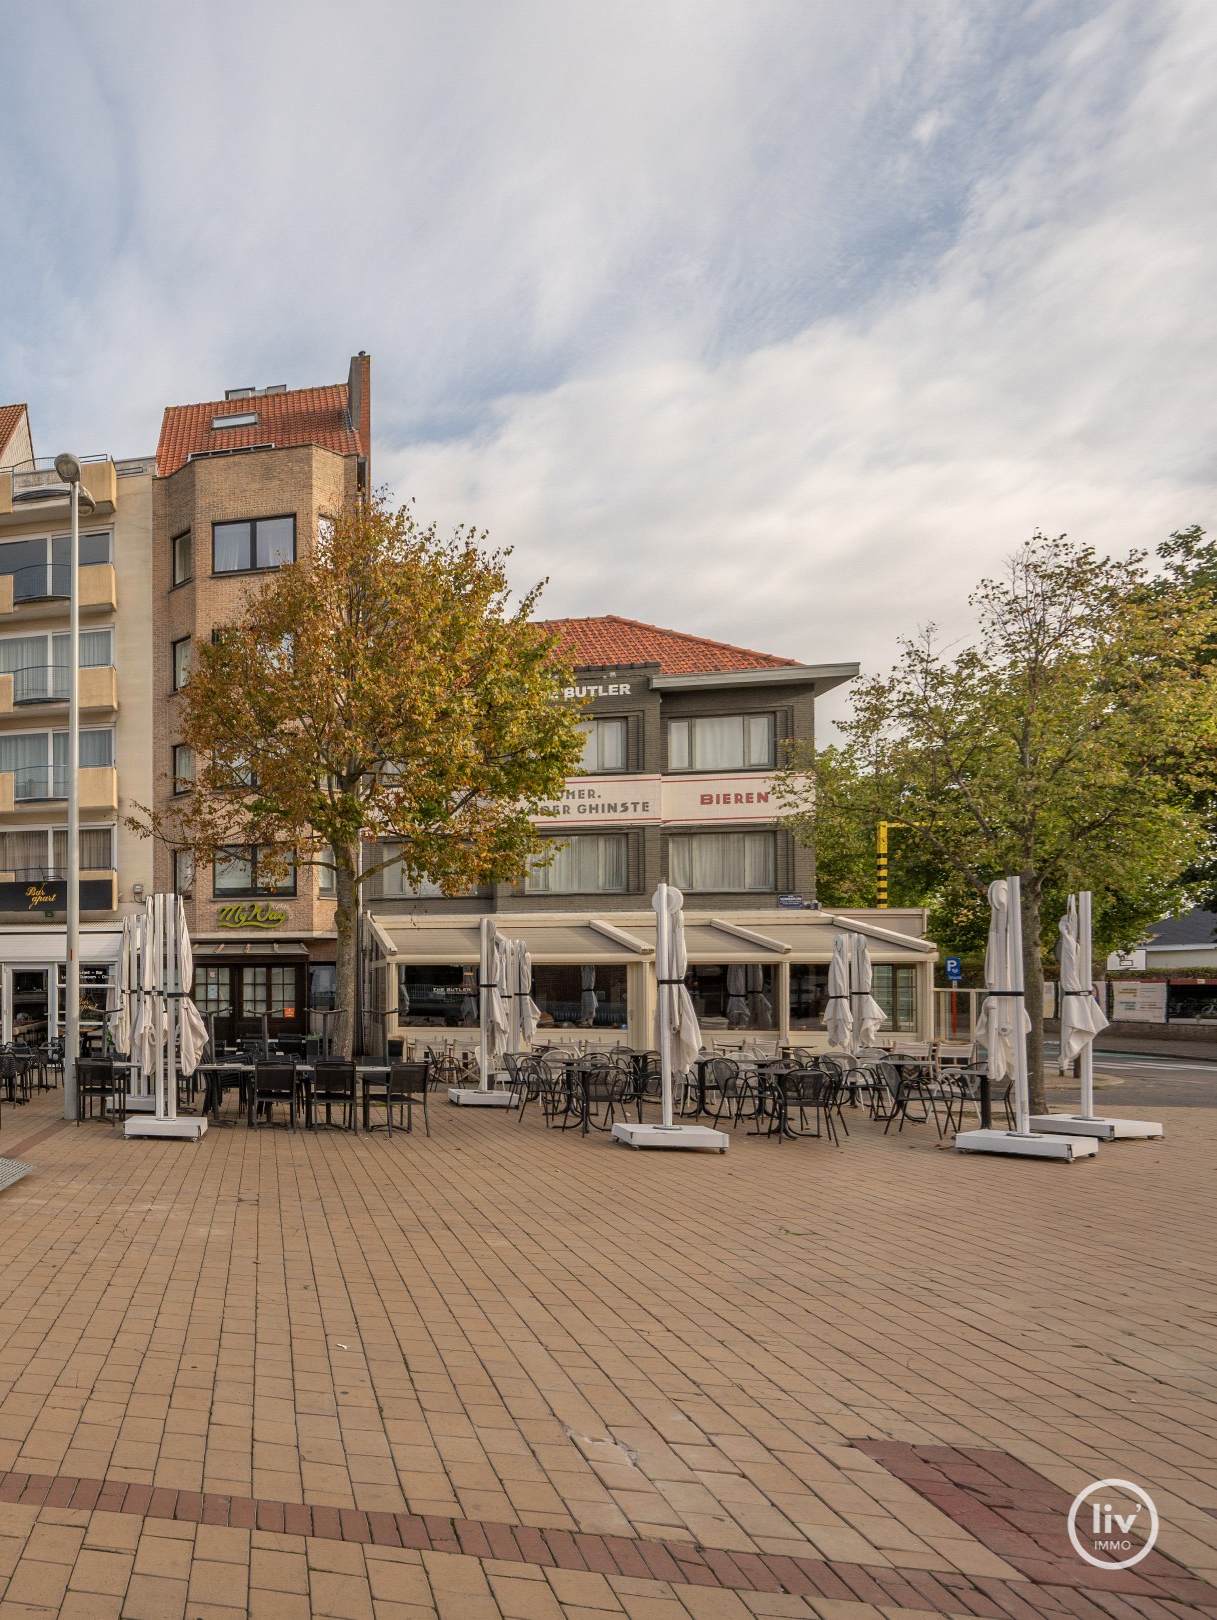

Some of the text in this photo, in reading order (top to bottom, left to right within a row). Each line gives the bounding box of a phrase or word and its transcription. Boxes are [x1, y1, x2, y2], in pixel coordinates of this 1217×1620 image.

[564, 684, 631, 699] BUTLER
[700, 791, 769, 805] BIEREN
[577, 802, 650, 815] GHINSTE
[25, 886, 46, 897] Bar
[31, 893, 57, 906] apart
